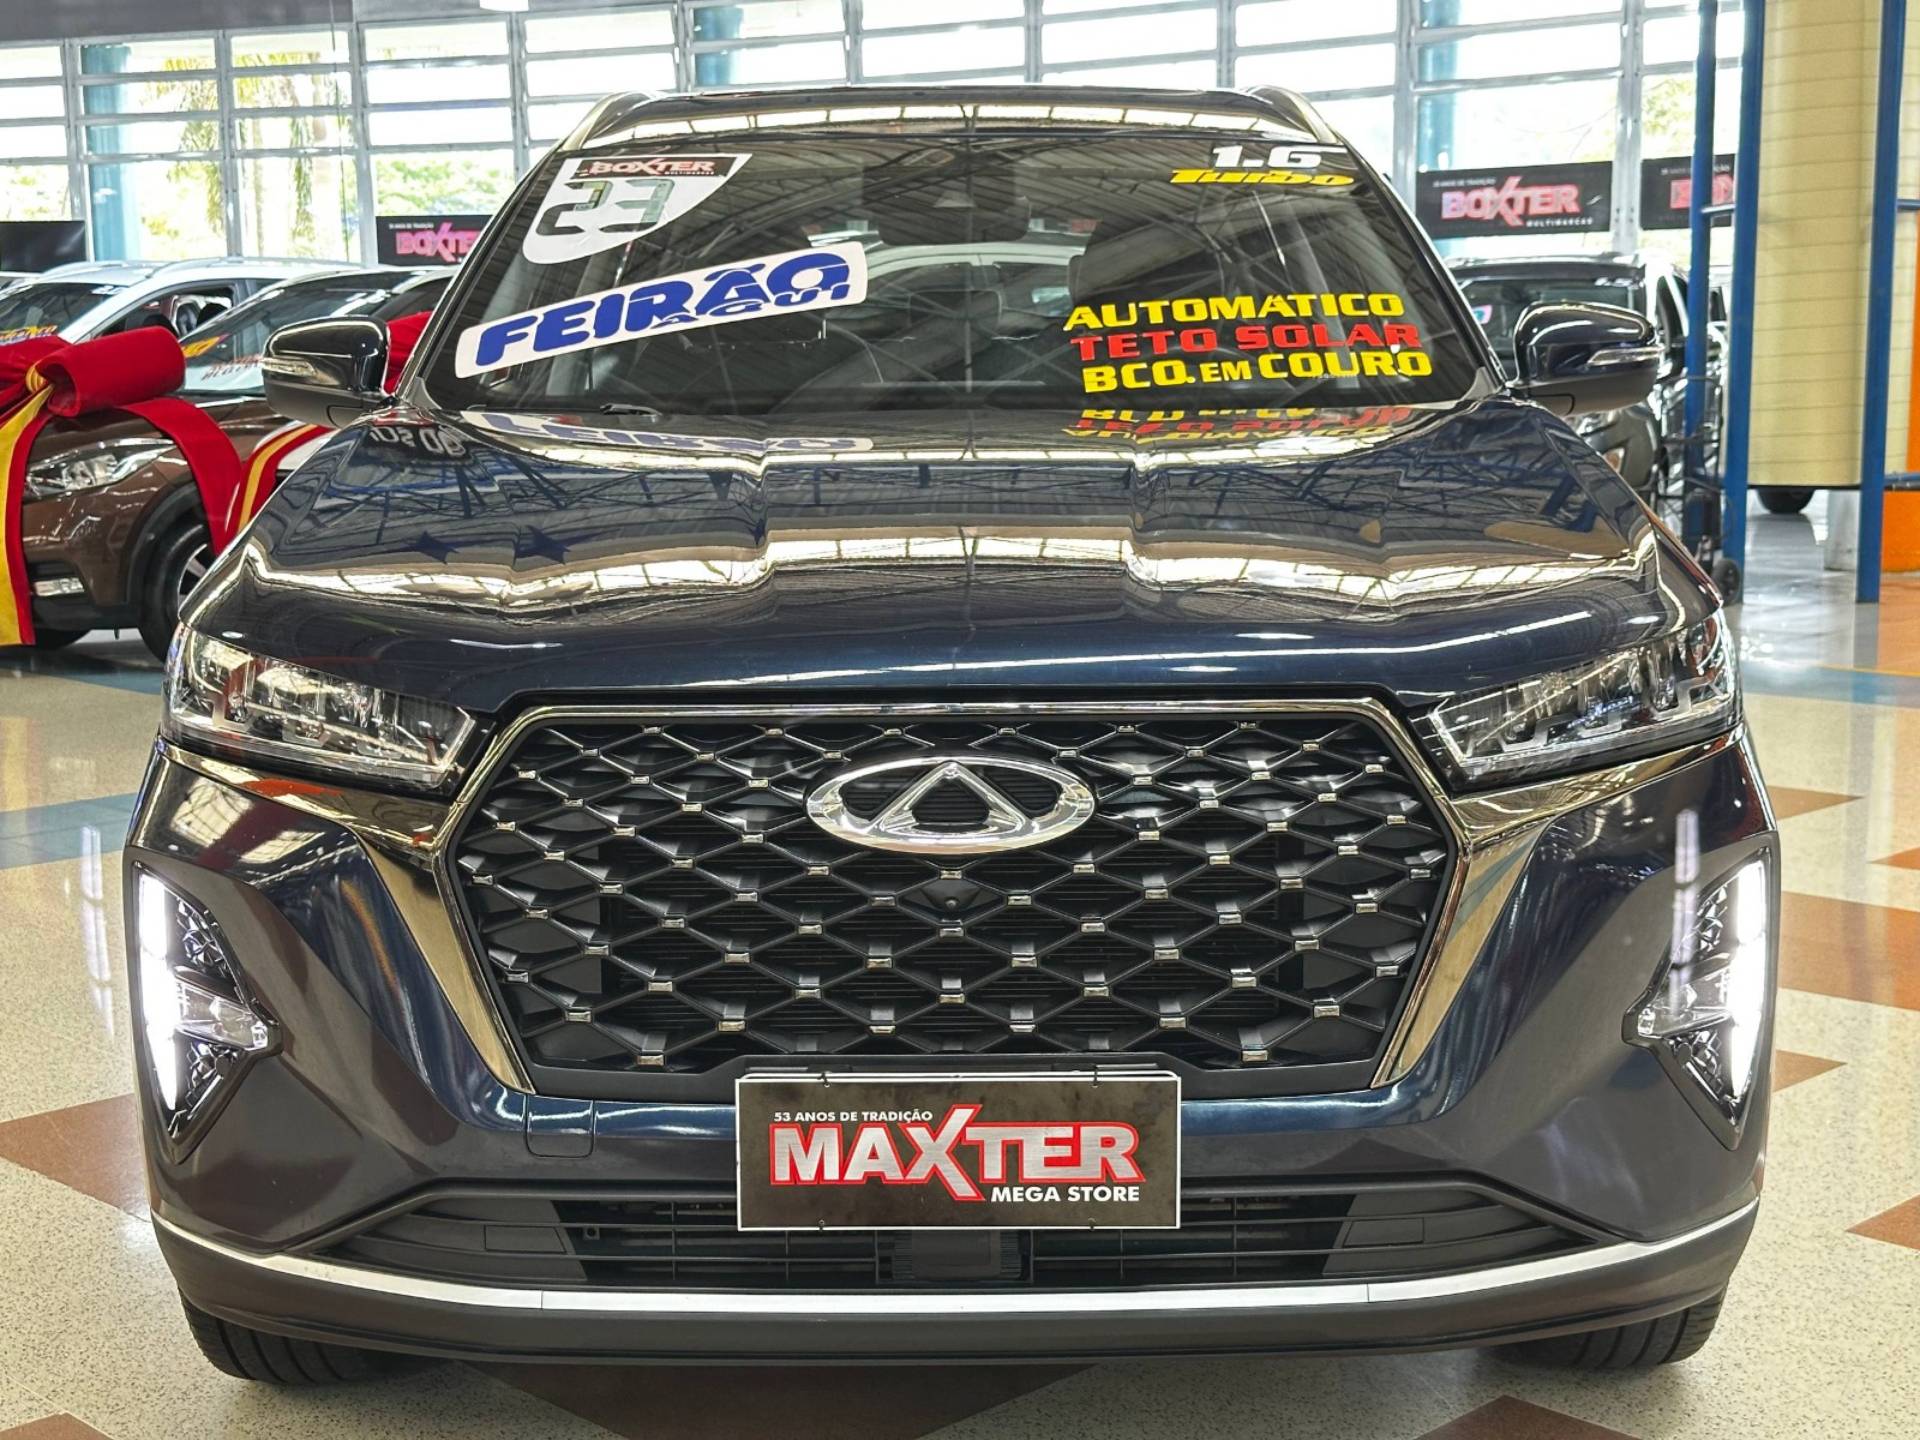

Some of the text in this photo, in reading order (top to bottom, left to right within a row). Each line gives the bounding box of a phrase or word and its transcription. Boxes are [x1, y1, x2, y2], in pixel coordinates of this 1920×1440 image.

[588, 157, 715, 176] BOXTER
[1213, 145, 1347, 168] 1.6
[536, 178, 675, 236] 23
[1441, 176, 1580, 227] BOXTER
[395, 222, 482, 262] BOXTE
[475, 252, 850, 367] FEIRÃO
[1070, 323, 1422, 361] TETO SOLAR
[1083, 351, 1432, 393] BCO. EM COURO
[773, 1109, 933, 1123] 53 ANOS DE TRADIÇÃO
[770, 1104, 1146, 1202] MAXTER
[990, 1186, 1140, 1202] MEGA STORE
